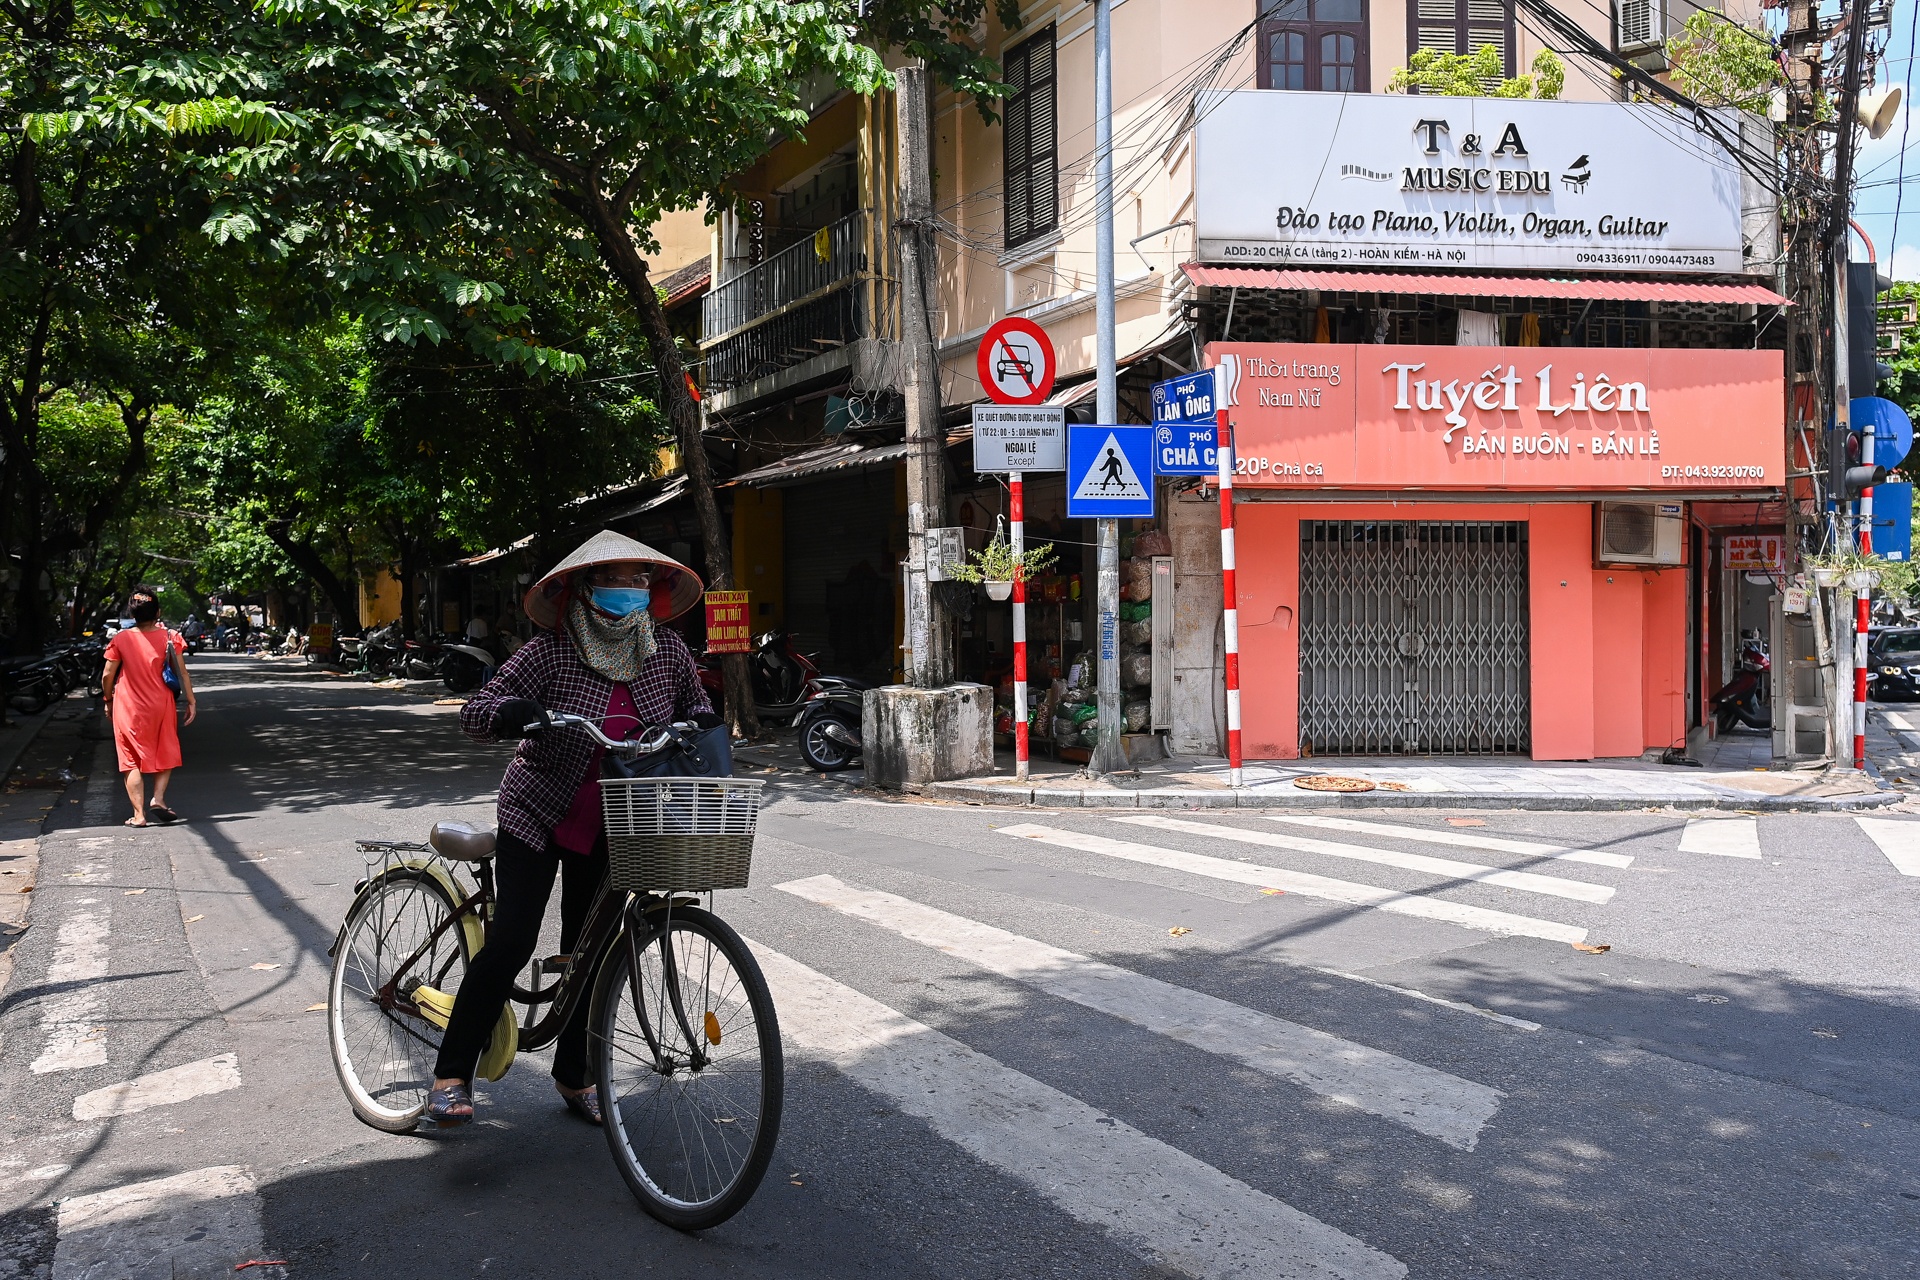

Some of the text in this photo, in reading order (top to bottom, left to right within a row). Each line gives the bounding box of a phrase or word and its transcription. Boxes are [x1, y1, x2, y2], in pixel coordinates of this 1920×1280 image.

[1413, 118, 1529, 158] T & A
[1400, 167, 1551, 194] MUSIC EDU
[1276, 206, 1669, 238] Đào tạo Piano, Violin, Organ, Guitar
[1223, 246, 1251, 257] ADD:
[1253, 247, 1266, 257] 20
[1268, 244, 1291, 257] CHẢ
[1294, 245, 1309, 258] CÁ
[1359, 246, 1390, 259] HOÀN
[1393, 244, 1419, 260] KIẾM
[1427, 247, 1442, 260] HÀ
[1447, 247, 1466, 263] NỘI
[1246, 357, 1341, 386] Thời trang
[1176, 380, 1196, 396] PHỐ
[1258, 387, 1321, 408] Nam Nữ
[1382, 361, 1651, 444] Tuyết Liên
[1157, 395, 1211, 421] LÃN ÔNG
[977, 413, 984, 422] XE
[1033, 413, 1046, 423] HOẠT
[1189, 429, 1212, 442] PHỐ
[1462, 429, 1506, 455] BÁN
[1511, 431, 1570, 455] BUÔN
[1591, 430, 1634, 456] BÁN
[1639, 429, 1660, 455] LẺ
[1005, 440, 1036, 455] NGOẠI LỆ
[1162, 442, 1220, 466] CHẢ C
[1007, 455, 1035, 467] Except
[1271, 462, 1301, 476] Chả
[1304, 462, 1323, 476] Cá
[1661, 465, 1764, 478] ĐT: 043.9230760
[1730, 537, 1762, 549] BÁNH
[1730, 549, 1745, 561] MÌ
[707, 592, 746, 604] NHẬN XAY
[713, 608, 727, 622] TAM
[738, 625, 749, 639] CHI
